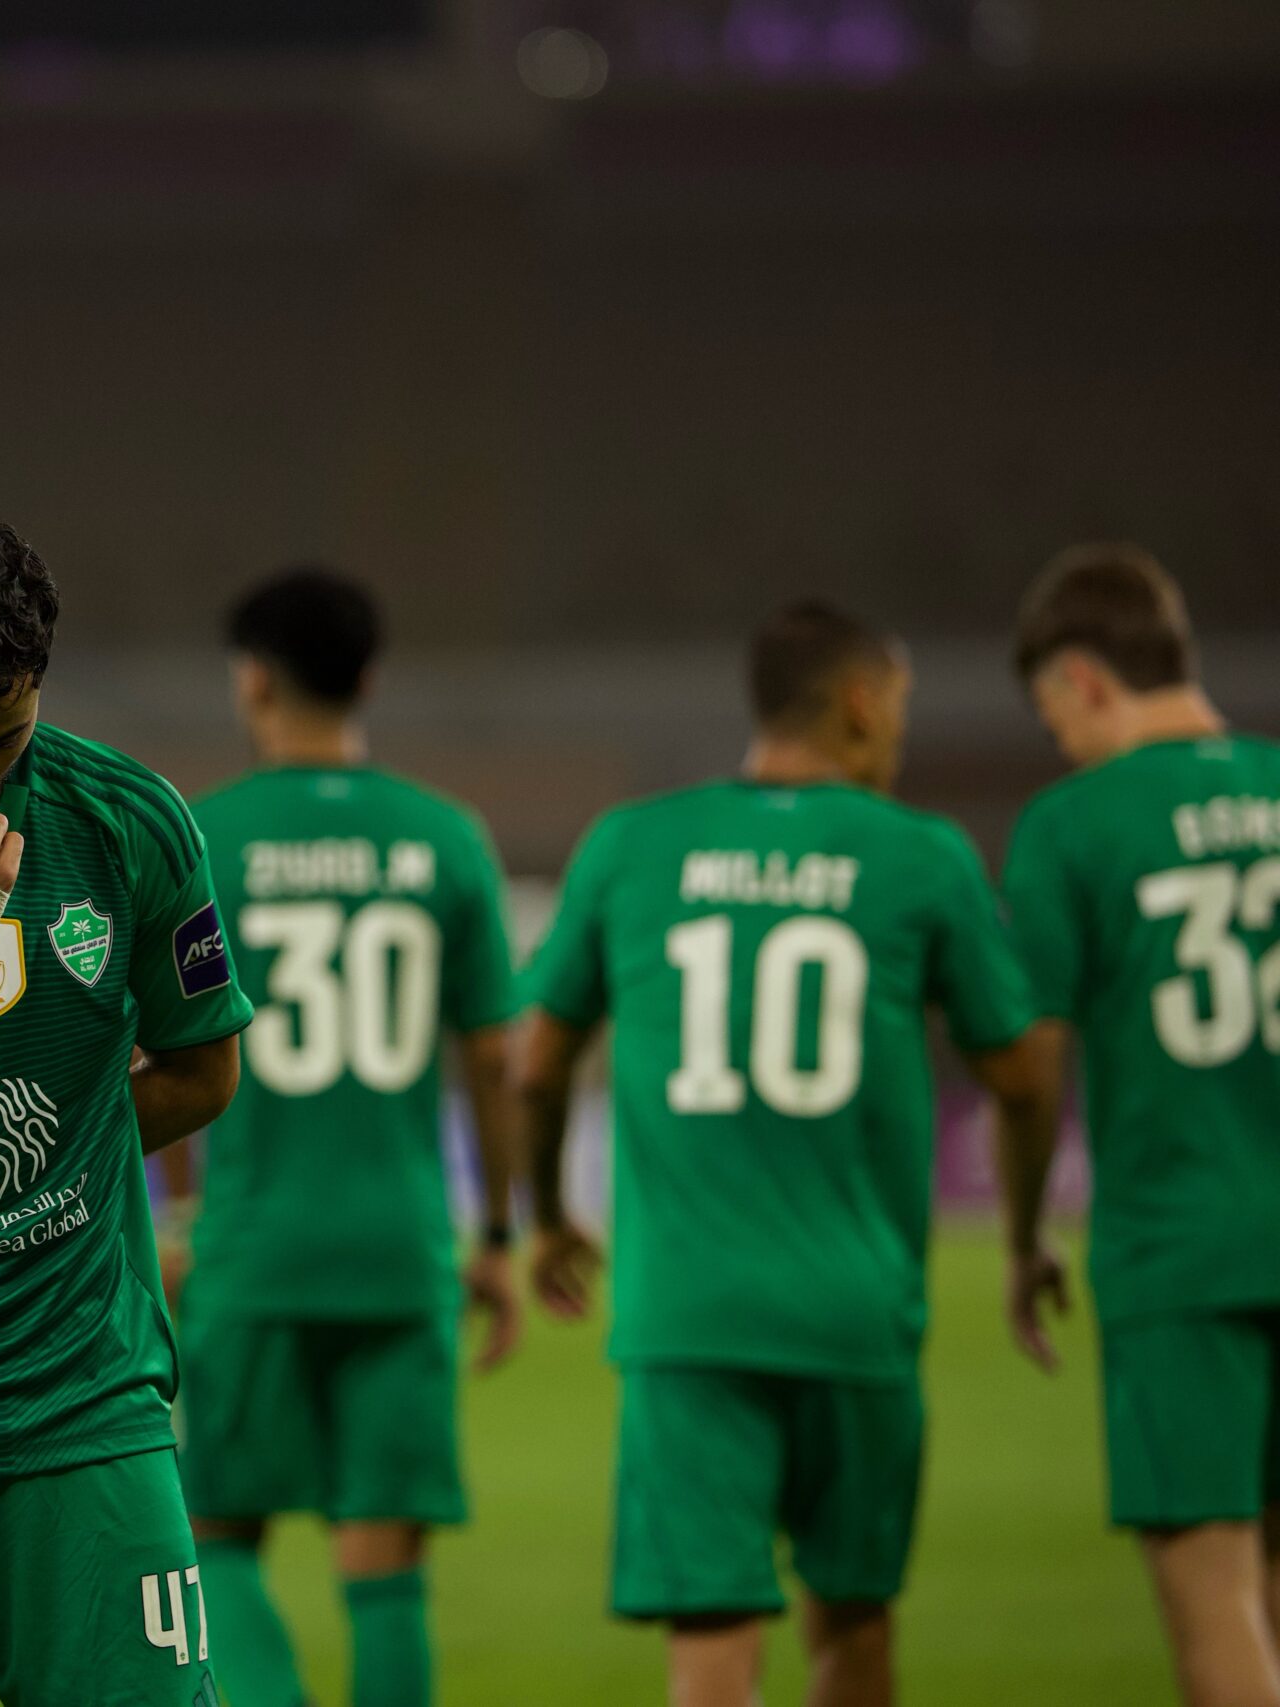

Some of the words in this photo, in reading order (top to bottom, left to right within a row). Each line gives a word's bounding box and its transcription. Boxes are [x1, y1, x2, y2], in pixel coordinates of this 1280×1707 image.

[182, 928, 224, 967] AFC
[242, 902, 440, 1096] 30
[666, 915, 867, 1117] 10
[29, 1198, 90, 1246] Global
[141, 1564, 209, 1666] 47
